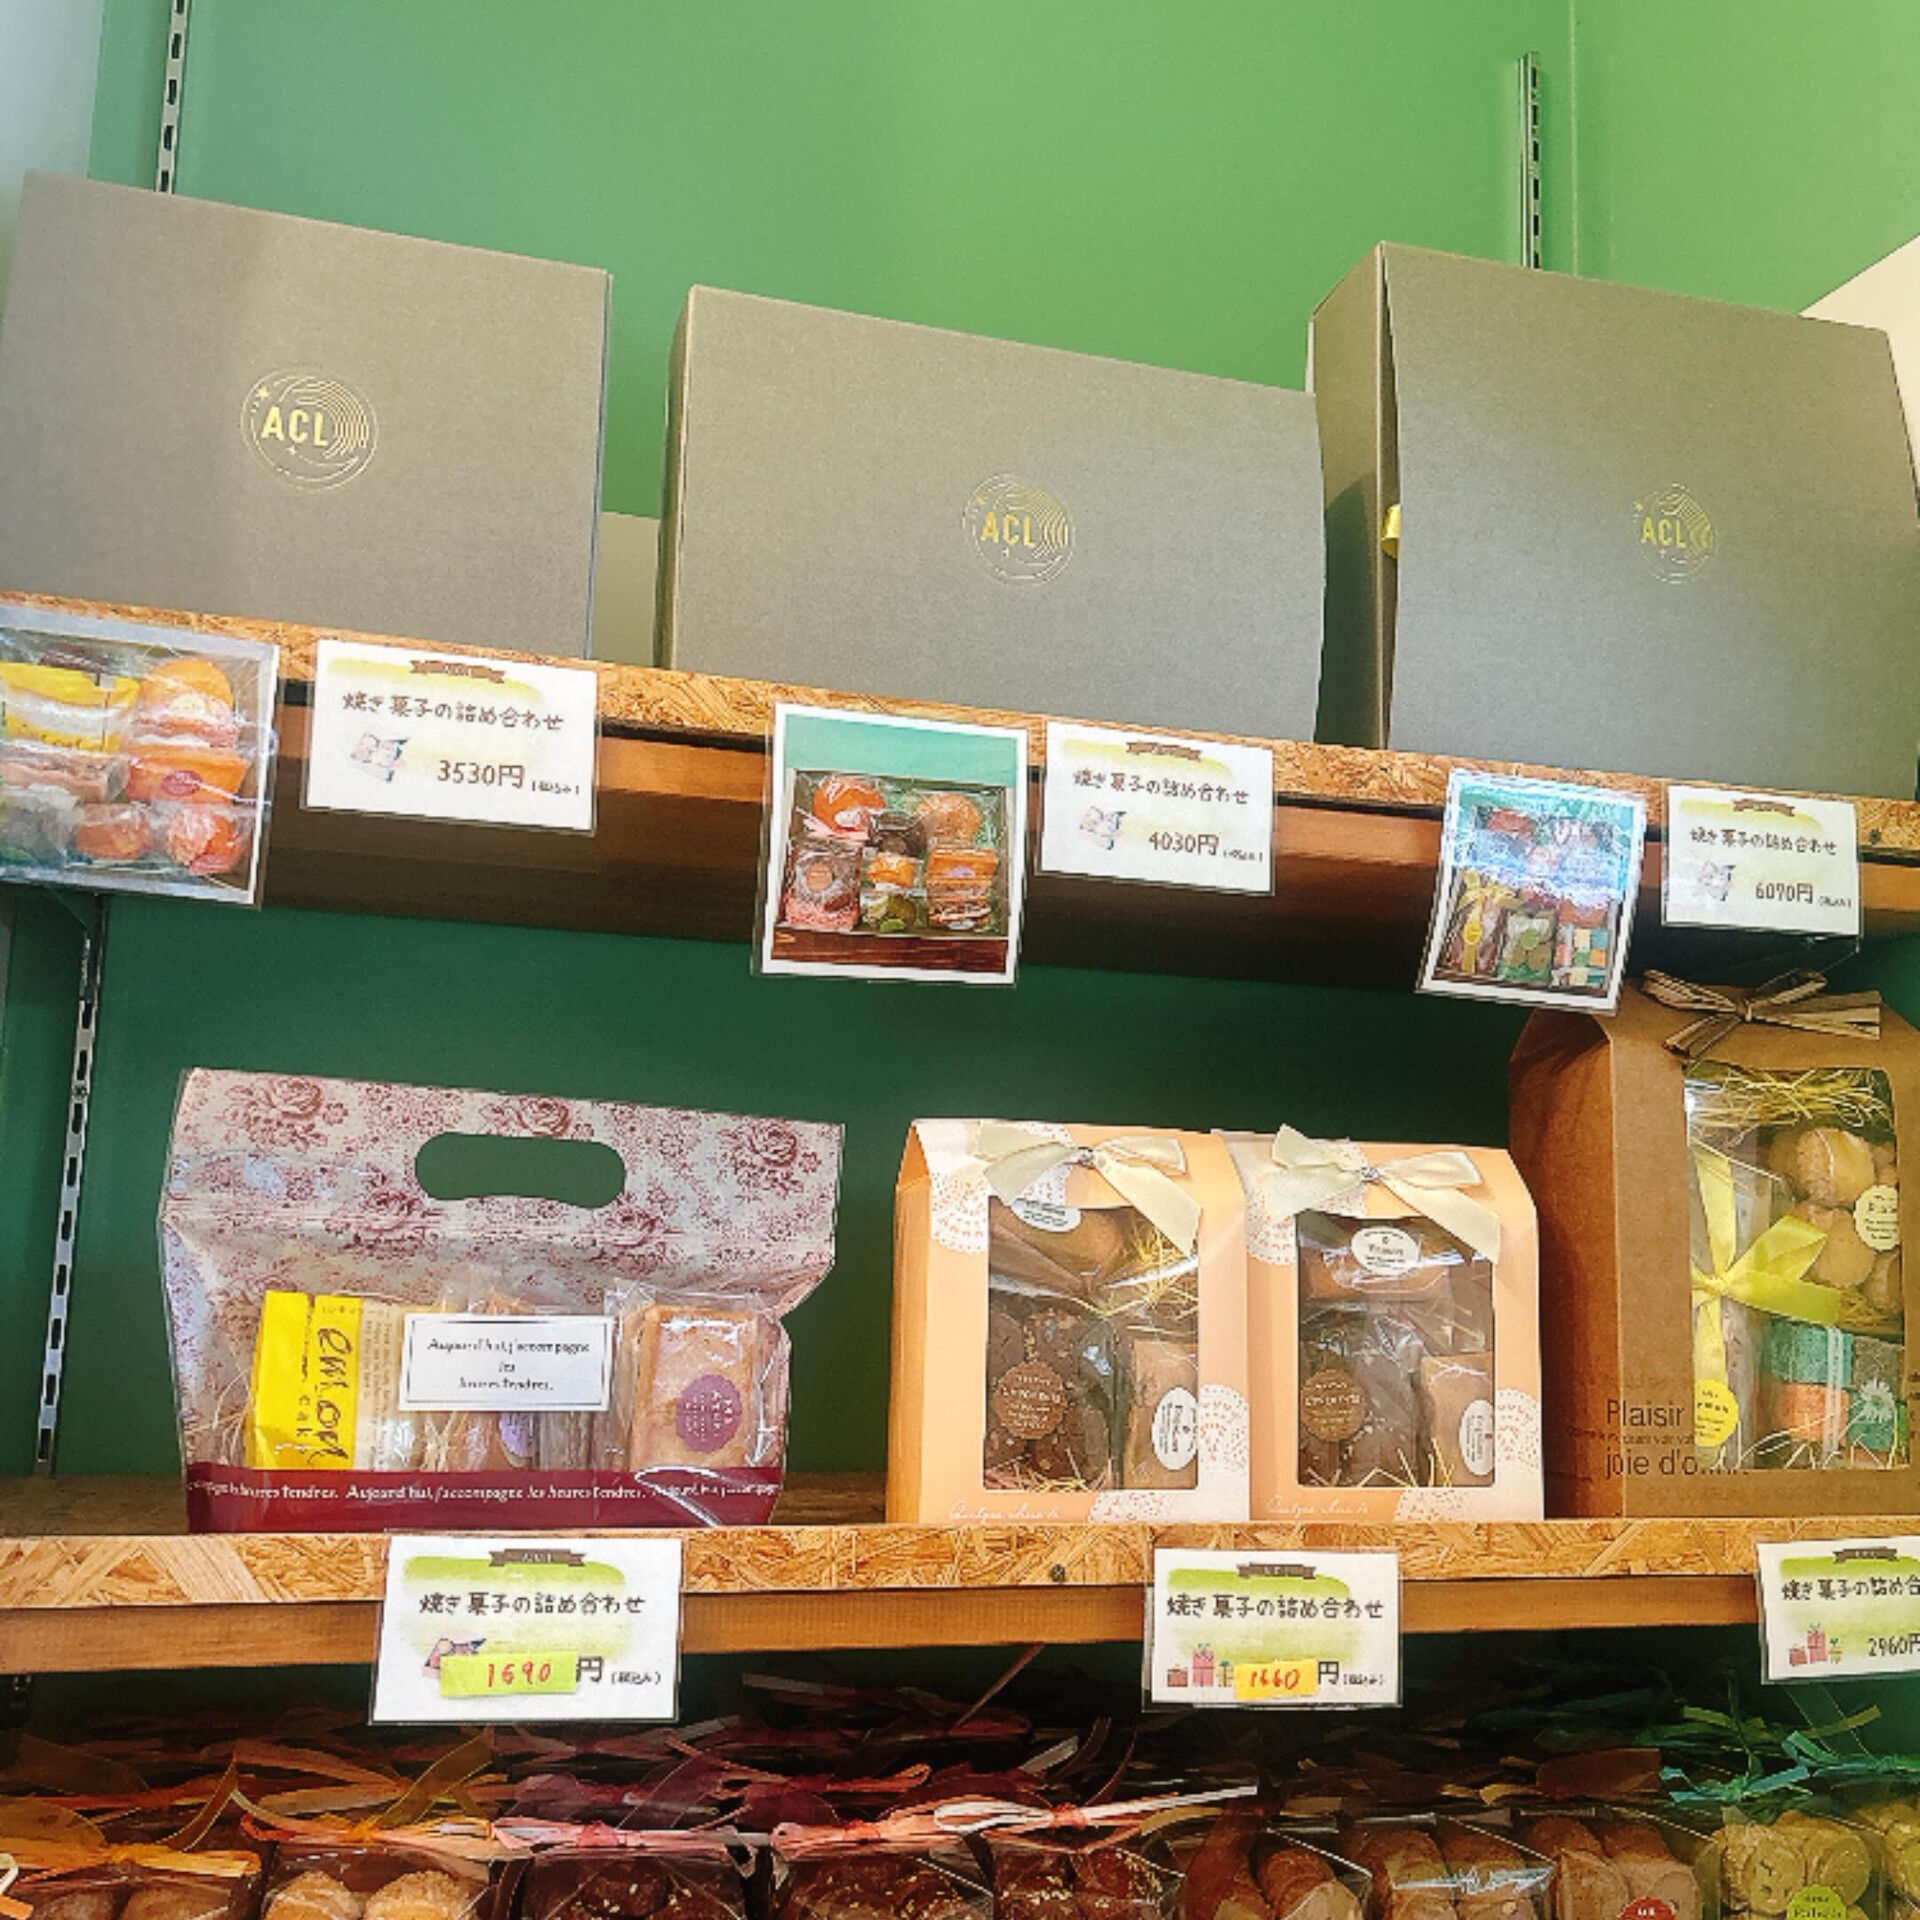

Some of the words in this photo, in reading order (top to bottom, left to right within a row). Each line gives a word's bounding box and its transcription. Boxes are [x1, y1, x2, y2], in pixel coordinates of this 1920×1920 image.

[261, 405, 329, 447] ACL
[980, 511, 1036, 548] ACL
[1640, 516, 1687, 549] ACL
[342, 690, 564, 730] 焼き菓子の詰め合わせ
[437, 759, 525, 789] 3530円
[1072, 767, 1250, 804] 焼き菓子の詰め合わせ
[1149, 831, 1220, 856] 4030円
[1690, 826, 1837, 856] 焼き菓子の詰め合わせ
[1606, 1398, 1685, 1428] Plaisir
[1604, 1447, 1650, 1480] joie
[419, 1591, 646, 1615] 焼き菓子の詰め合わせ
[1167, 1593, 1384, 1619] 焼き菓子の詰め合わせ
[487, 1660, 553, 1688] 1690
[576, 1656, 603, 1683] 円
[1317, 1660, 1340, 1685] 円
